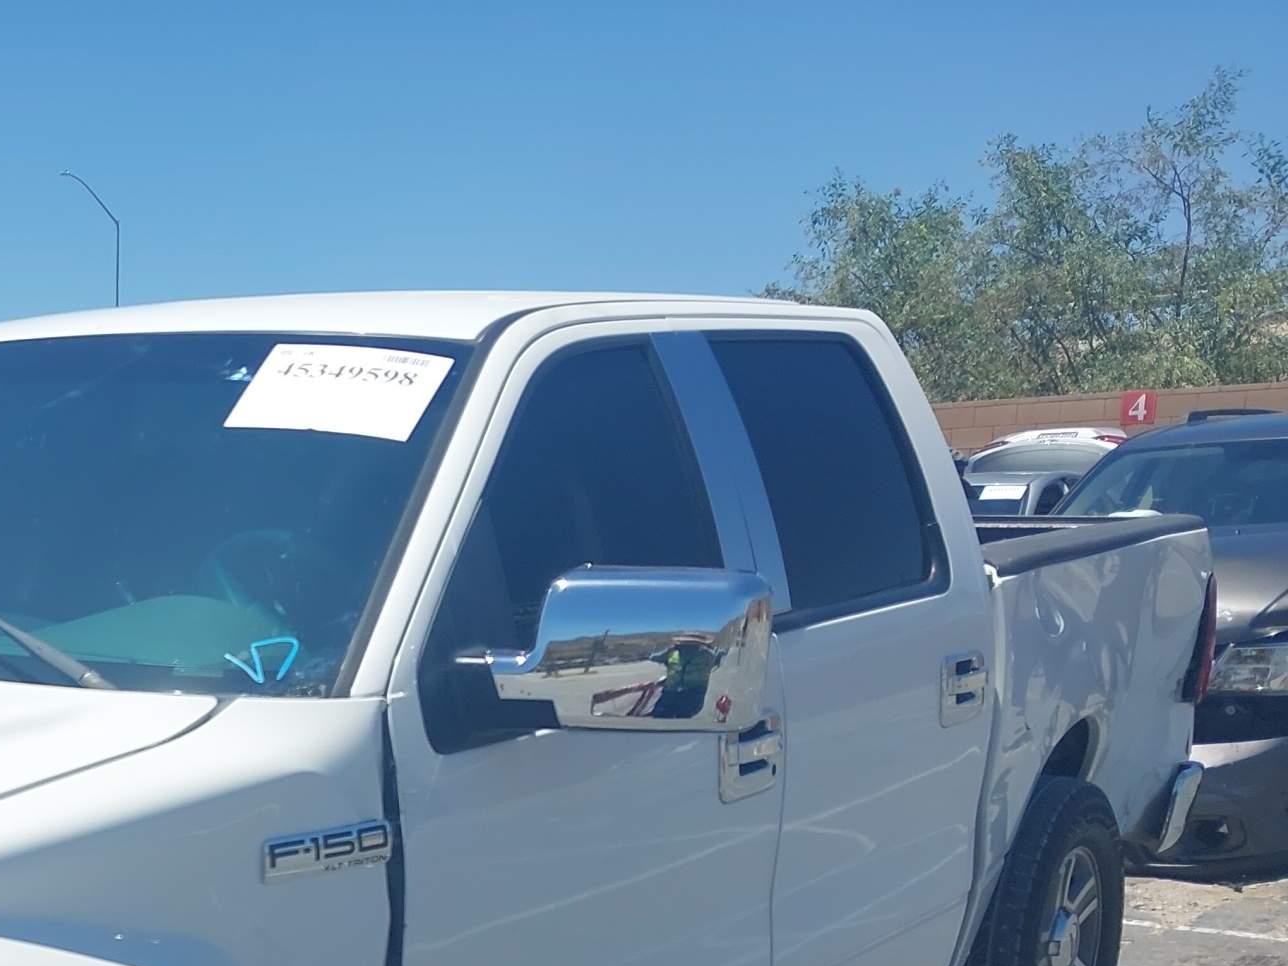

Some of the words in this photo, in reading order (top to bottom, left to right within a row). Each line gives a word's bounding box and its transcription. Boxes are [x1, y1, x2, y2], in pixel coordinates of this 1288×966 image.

[276, 362, 419, 387] 45349598
[1128, 393, 1147, 421] 4
[268, 825, 388, 869] F-150
[347, 855, 388, 868] TRITON
